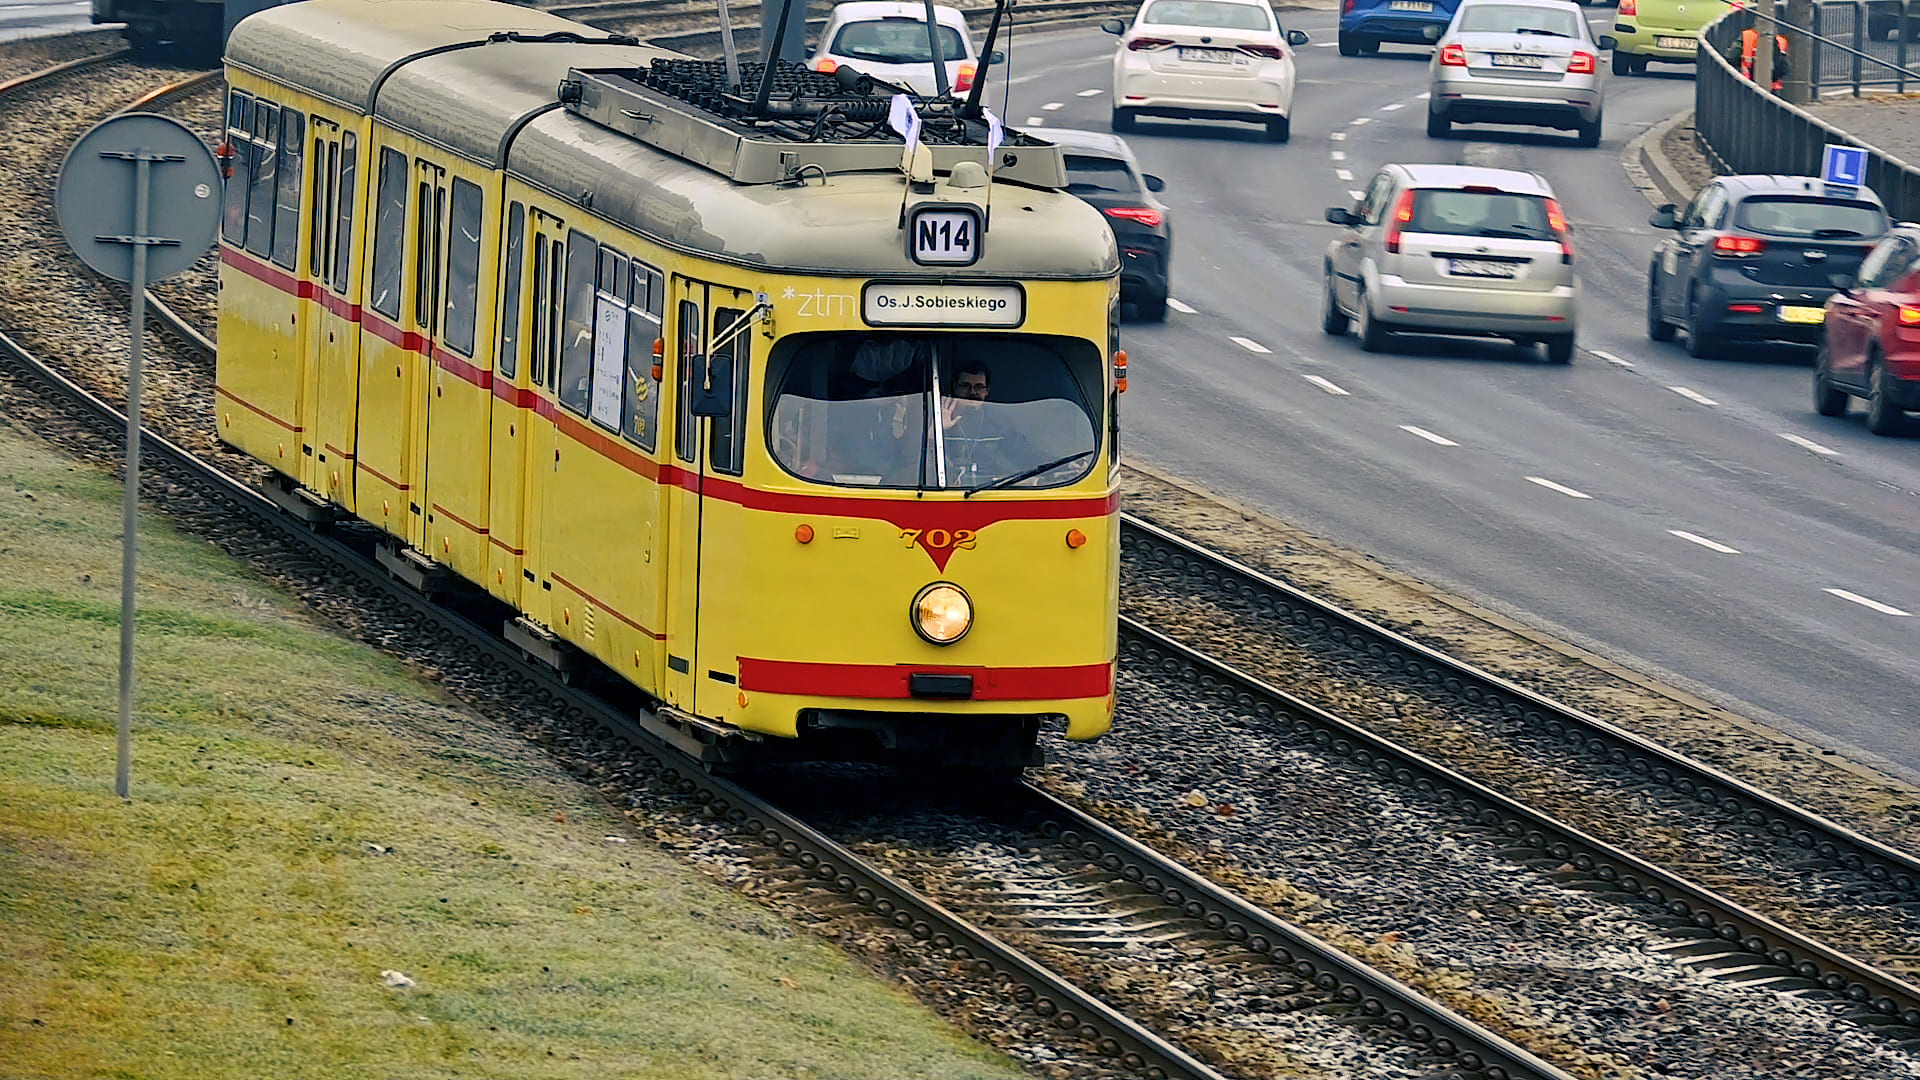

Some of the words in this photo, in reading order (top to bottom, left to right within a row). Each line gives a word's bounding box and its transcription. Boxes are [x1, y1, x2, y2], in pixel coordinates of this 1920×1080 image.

[1834, 151, 1856, 180] L
[919, 220, 970, 252] N14
[877, 295, 1007, 311] Os.J.Sobieskiego
[898, 528, 977, 551] 702
